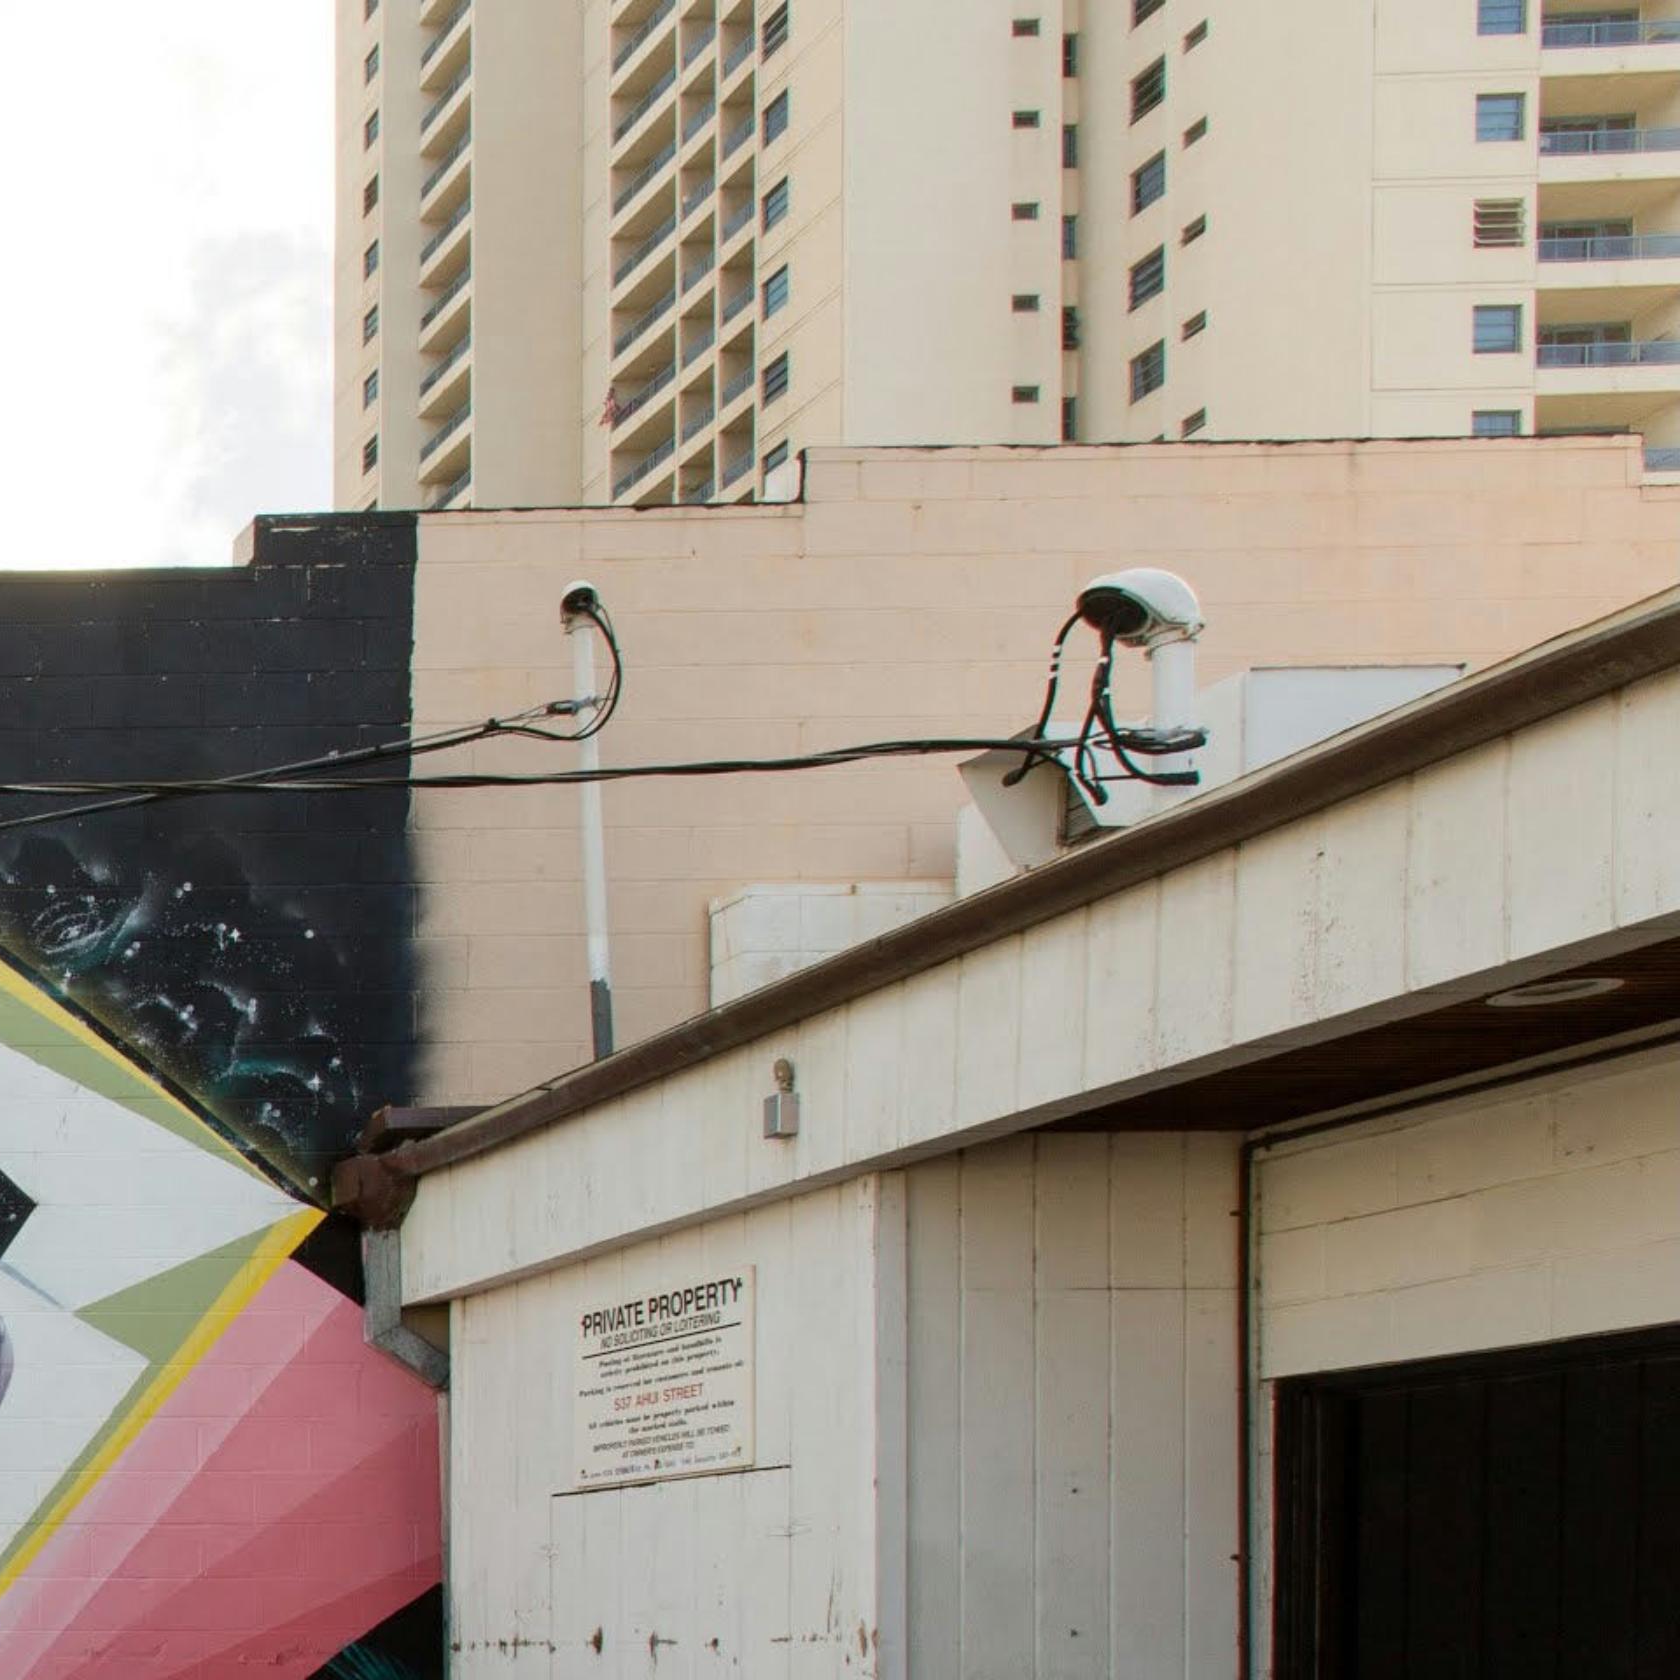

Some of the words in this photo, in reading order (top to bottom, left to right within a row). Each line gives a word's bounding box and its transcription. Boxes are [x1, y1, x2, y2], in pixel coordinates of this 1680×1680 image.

[583, 1300, 645, 1338] PRIVATE
[648, 1278, 742, 1322] PROPERTY
[600, 1336, 612, 1349] NO
[613, 1325, 658, 1346] SOLICITING
[660, 1321, 673, 1336] OR
[674, 1311, 720, 1333] LOITERING
[662, 1382, 704, 1402] STREET
